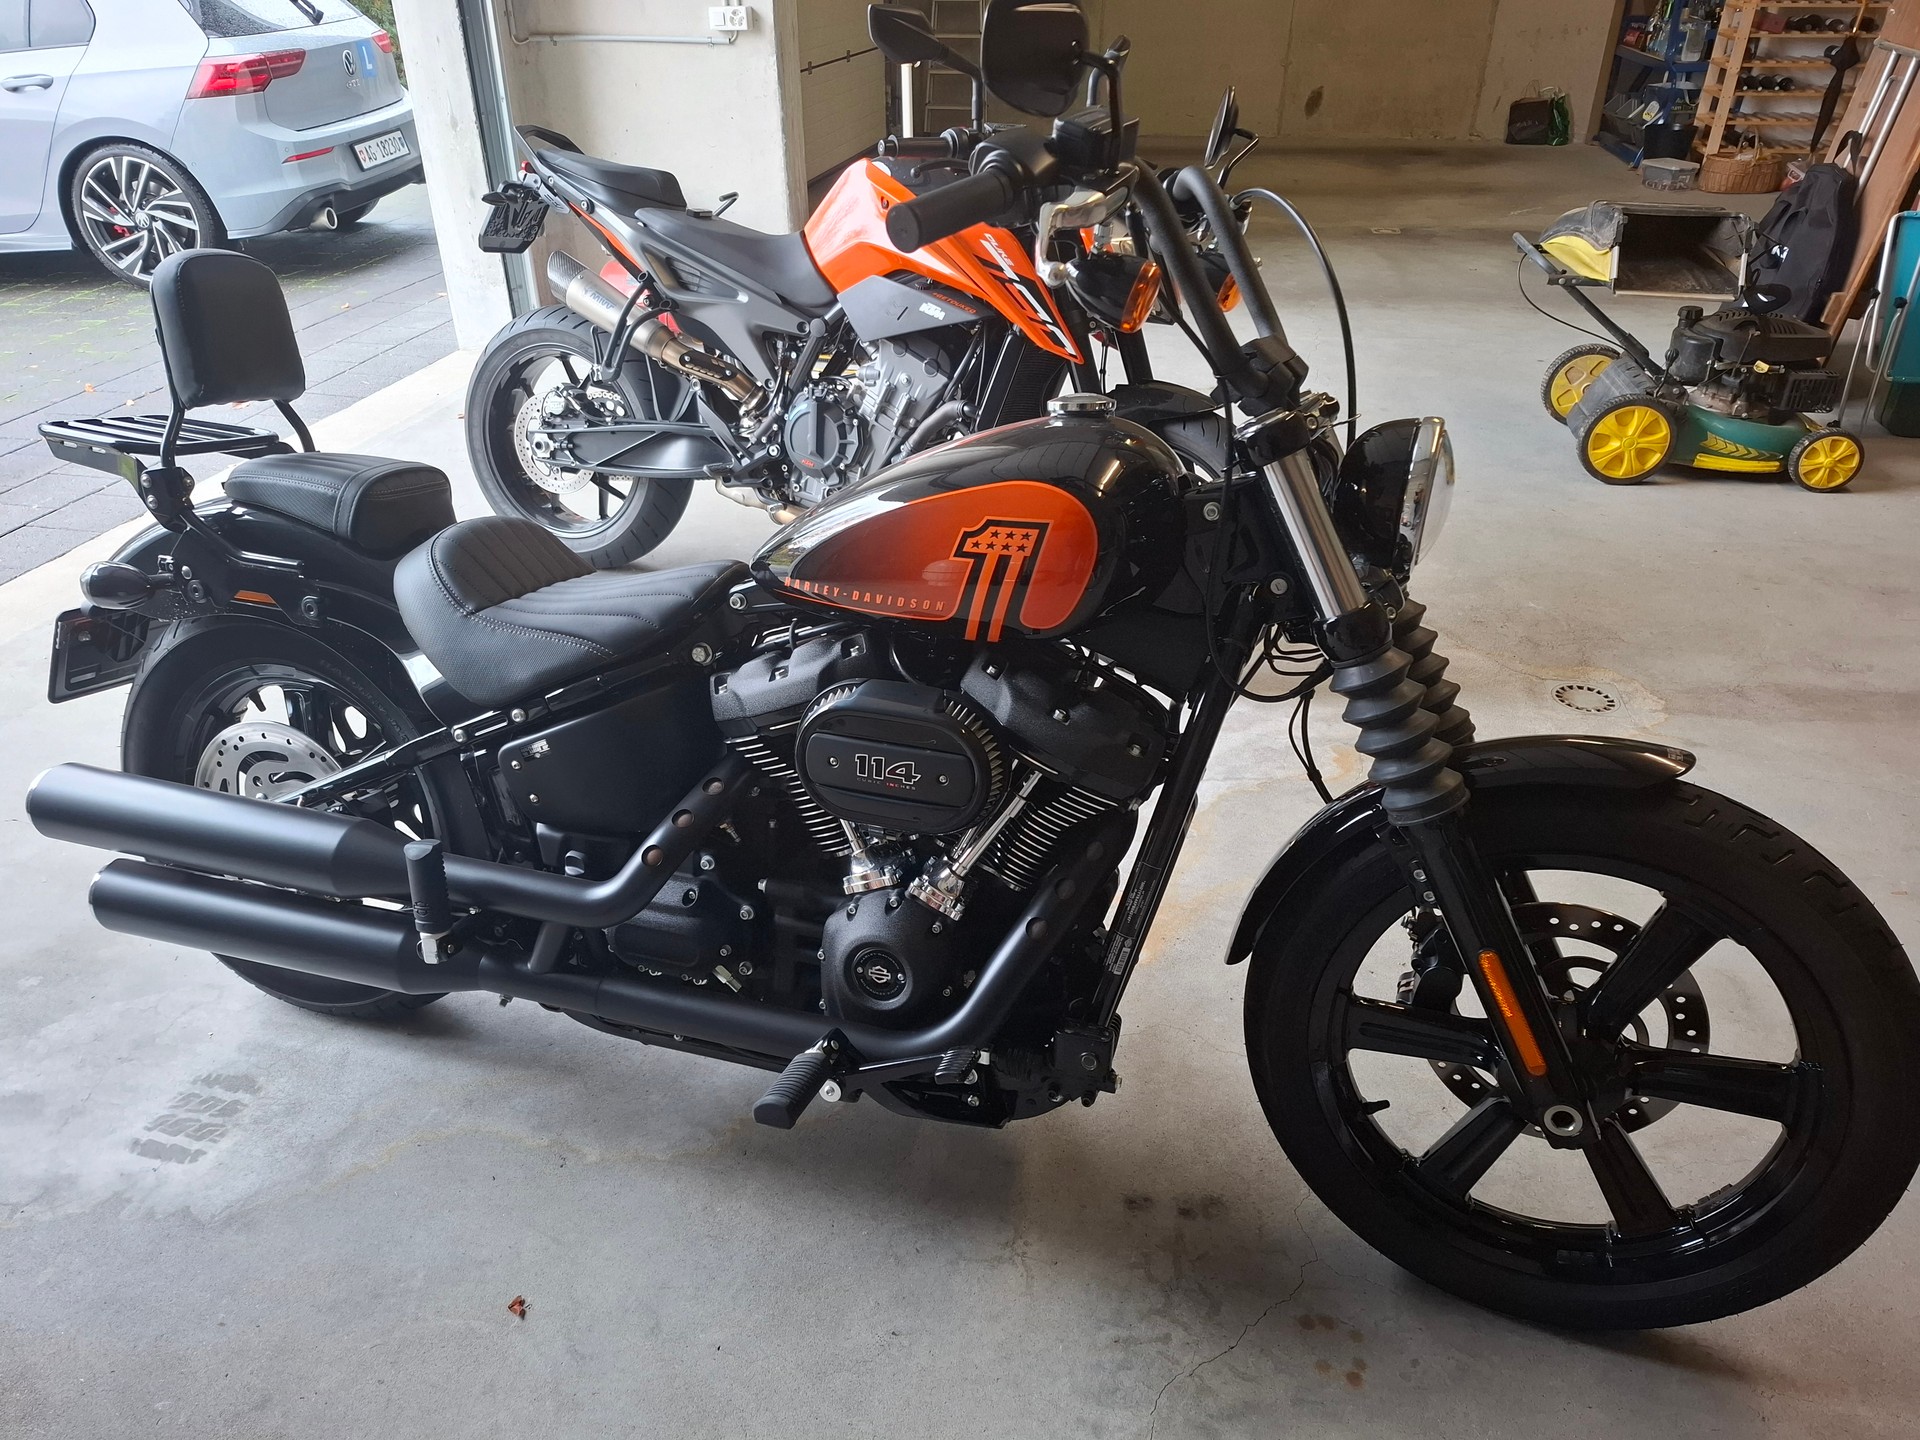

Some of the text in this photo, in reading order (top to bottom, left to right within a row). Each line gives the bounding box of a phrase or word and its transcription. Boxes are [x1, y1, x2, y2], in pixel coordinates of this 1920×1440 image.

[362, 46, 373, 70] L
[984, 233, 1014, 267] DUKE
[919, 302, 946, 321] KTM
[784, 577, 945, 612] HARLEY-DAVIDSON
[855, 754, 921, 784] 114
